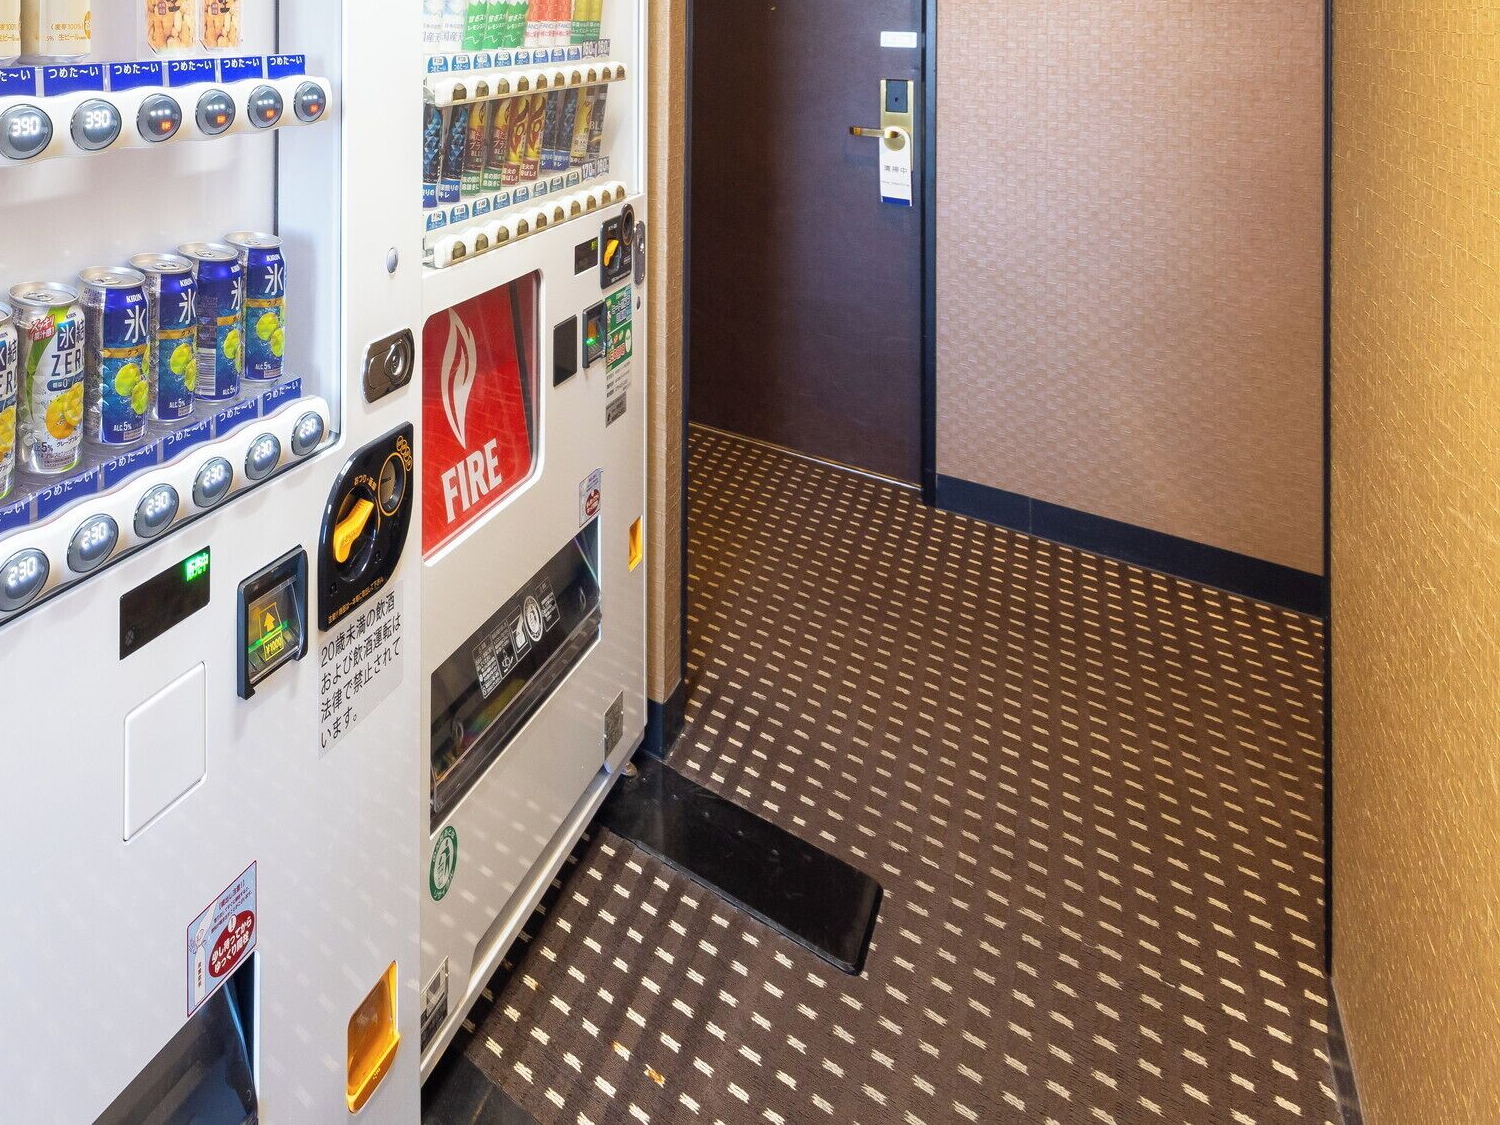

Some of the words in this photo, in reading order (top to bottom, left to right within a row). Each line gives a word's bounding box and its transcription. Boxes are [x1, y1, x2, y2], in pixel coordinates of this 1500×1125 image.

[10, 117, 40, 136] 390
[84, 111, 111, 128] 390
[440, 437, 503, 525] FIRE
[81, 523, 106, 550] 230
[7, 557, 36, 586] 230
[321, 591, 395, 668] 20歳未満の飲酒
[321, 612, 402, 695] および飲酒運転は
[321, 636, 401, 724] 法律で禁止されて
[321, 706, 358, 748] います。
